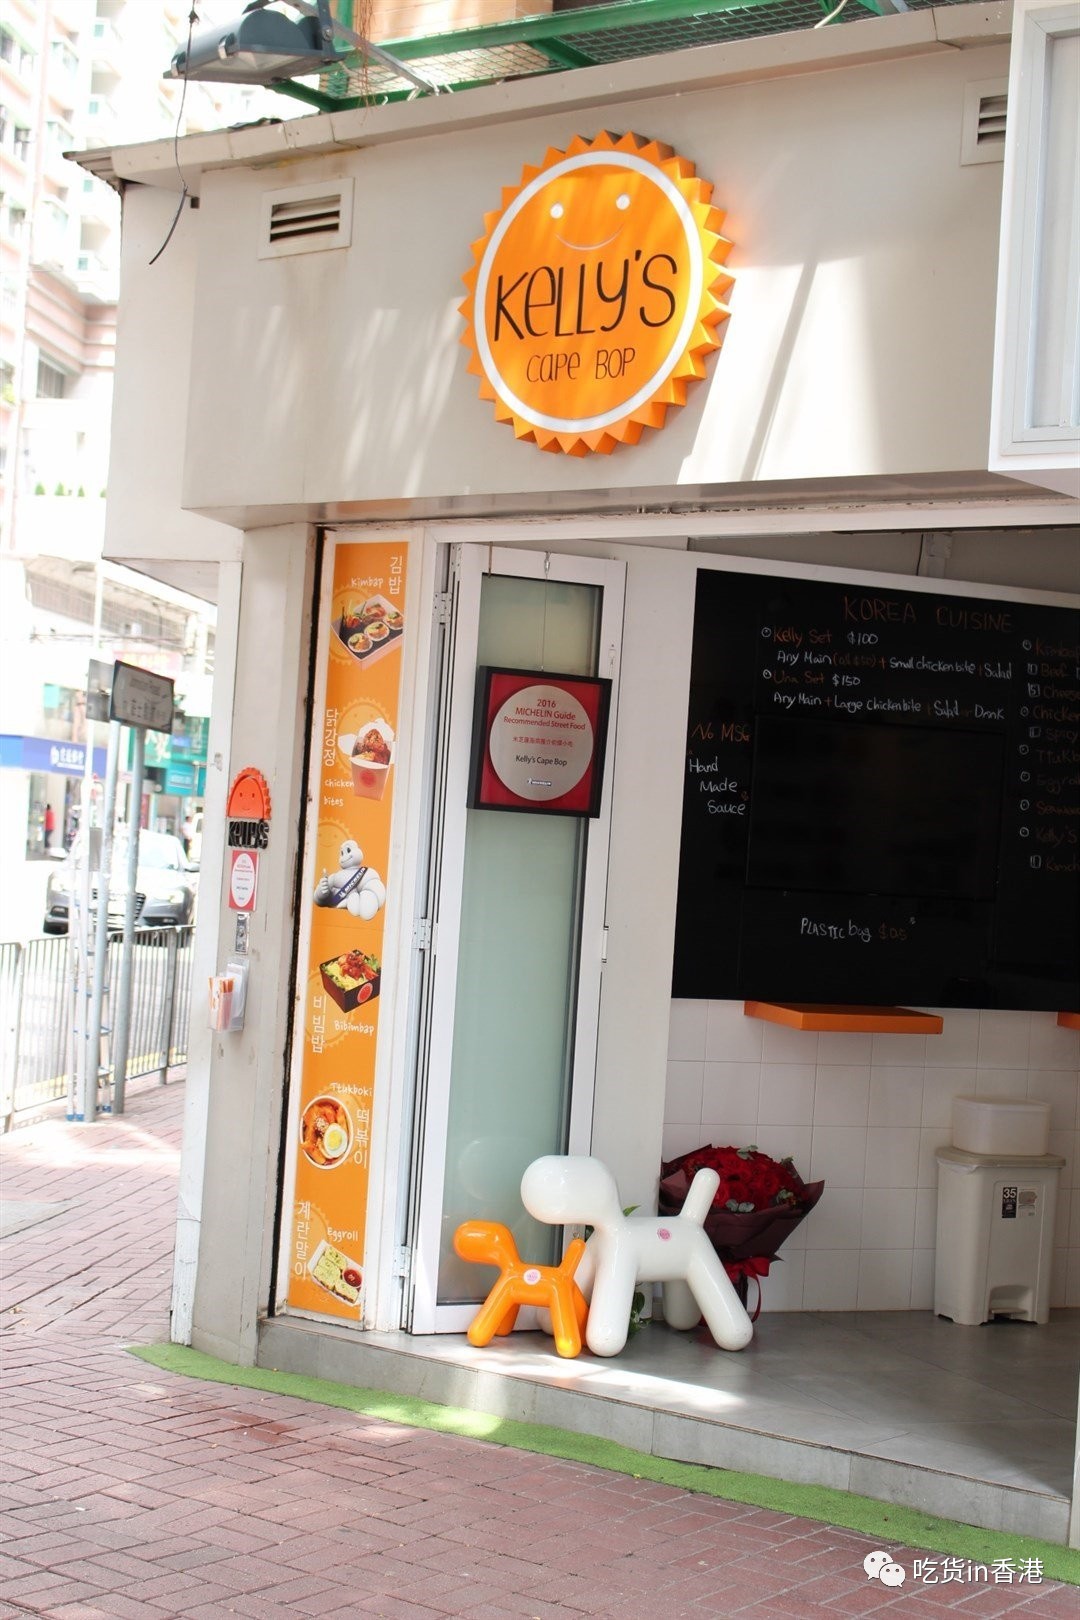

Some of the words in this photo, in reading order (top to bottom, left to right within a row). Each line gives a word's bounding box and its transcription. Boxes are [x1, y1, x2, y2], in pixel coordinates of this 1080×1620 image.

[595, 347, 636, 380] BOP
[351, 577, 384, 589] Kimbap
[389, 555, 403, 595] 김밥
[844, 595, 917, 624] KOREA
[936, 605, 1013, 632] CUISINE
[774, 627, 803, 648] Kelly
[809, 629, 832, 644] Set
[847, 631, 878, 645] $100
[777, 650, 800, 666] Any
[803, 650, 832, 664] Main
[984, 661, 1012, 680] Salad
[804, 670, 825, 684] Set
[832, 673, 861, 687] $150
[537, 699, 557, 708] 2016
[774, 691, 797, 709] Any
[798, 692, 822, 705] Main
[834, 694, 863, 713] Large
[504, 716, 550, 727] Recommended
[551, 721, 569, 729] Street
[516, 707, 553, 718] MICHELIN
[554, 711, 576, 720] Guide
[324, 708, 339, 767] 닭강정
[691, 722, 714, 740] No
[721, 722, 751, 742] MSG
[515, 755, 535, 764] Kelly's
[536, 757, 553, 766] Cape
[554, 758, 567, 767] Bop
[690, 756, 719, 773] Hand
[700, 777, 738, 793] Made
[707, 799, 746, 816] Sauce
[848, 919, 872, 942] bag
[311, 994, 327, 1054] 비빔밥
[333, 1019, 375, 1036] Bibimbap
[354, 1108, 370, 1168] 떡볶이
[1003, 1188, 1017, 1199] 35
[294, 1201, 311, 1280] 계란말이
[327, 1227, 359, 1242] Eggroll
